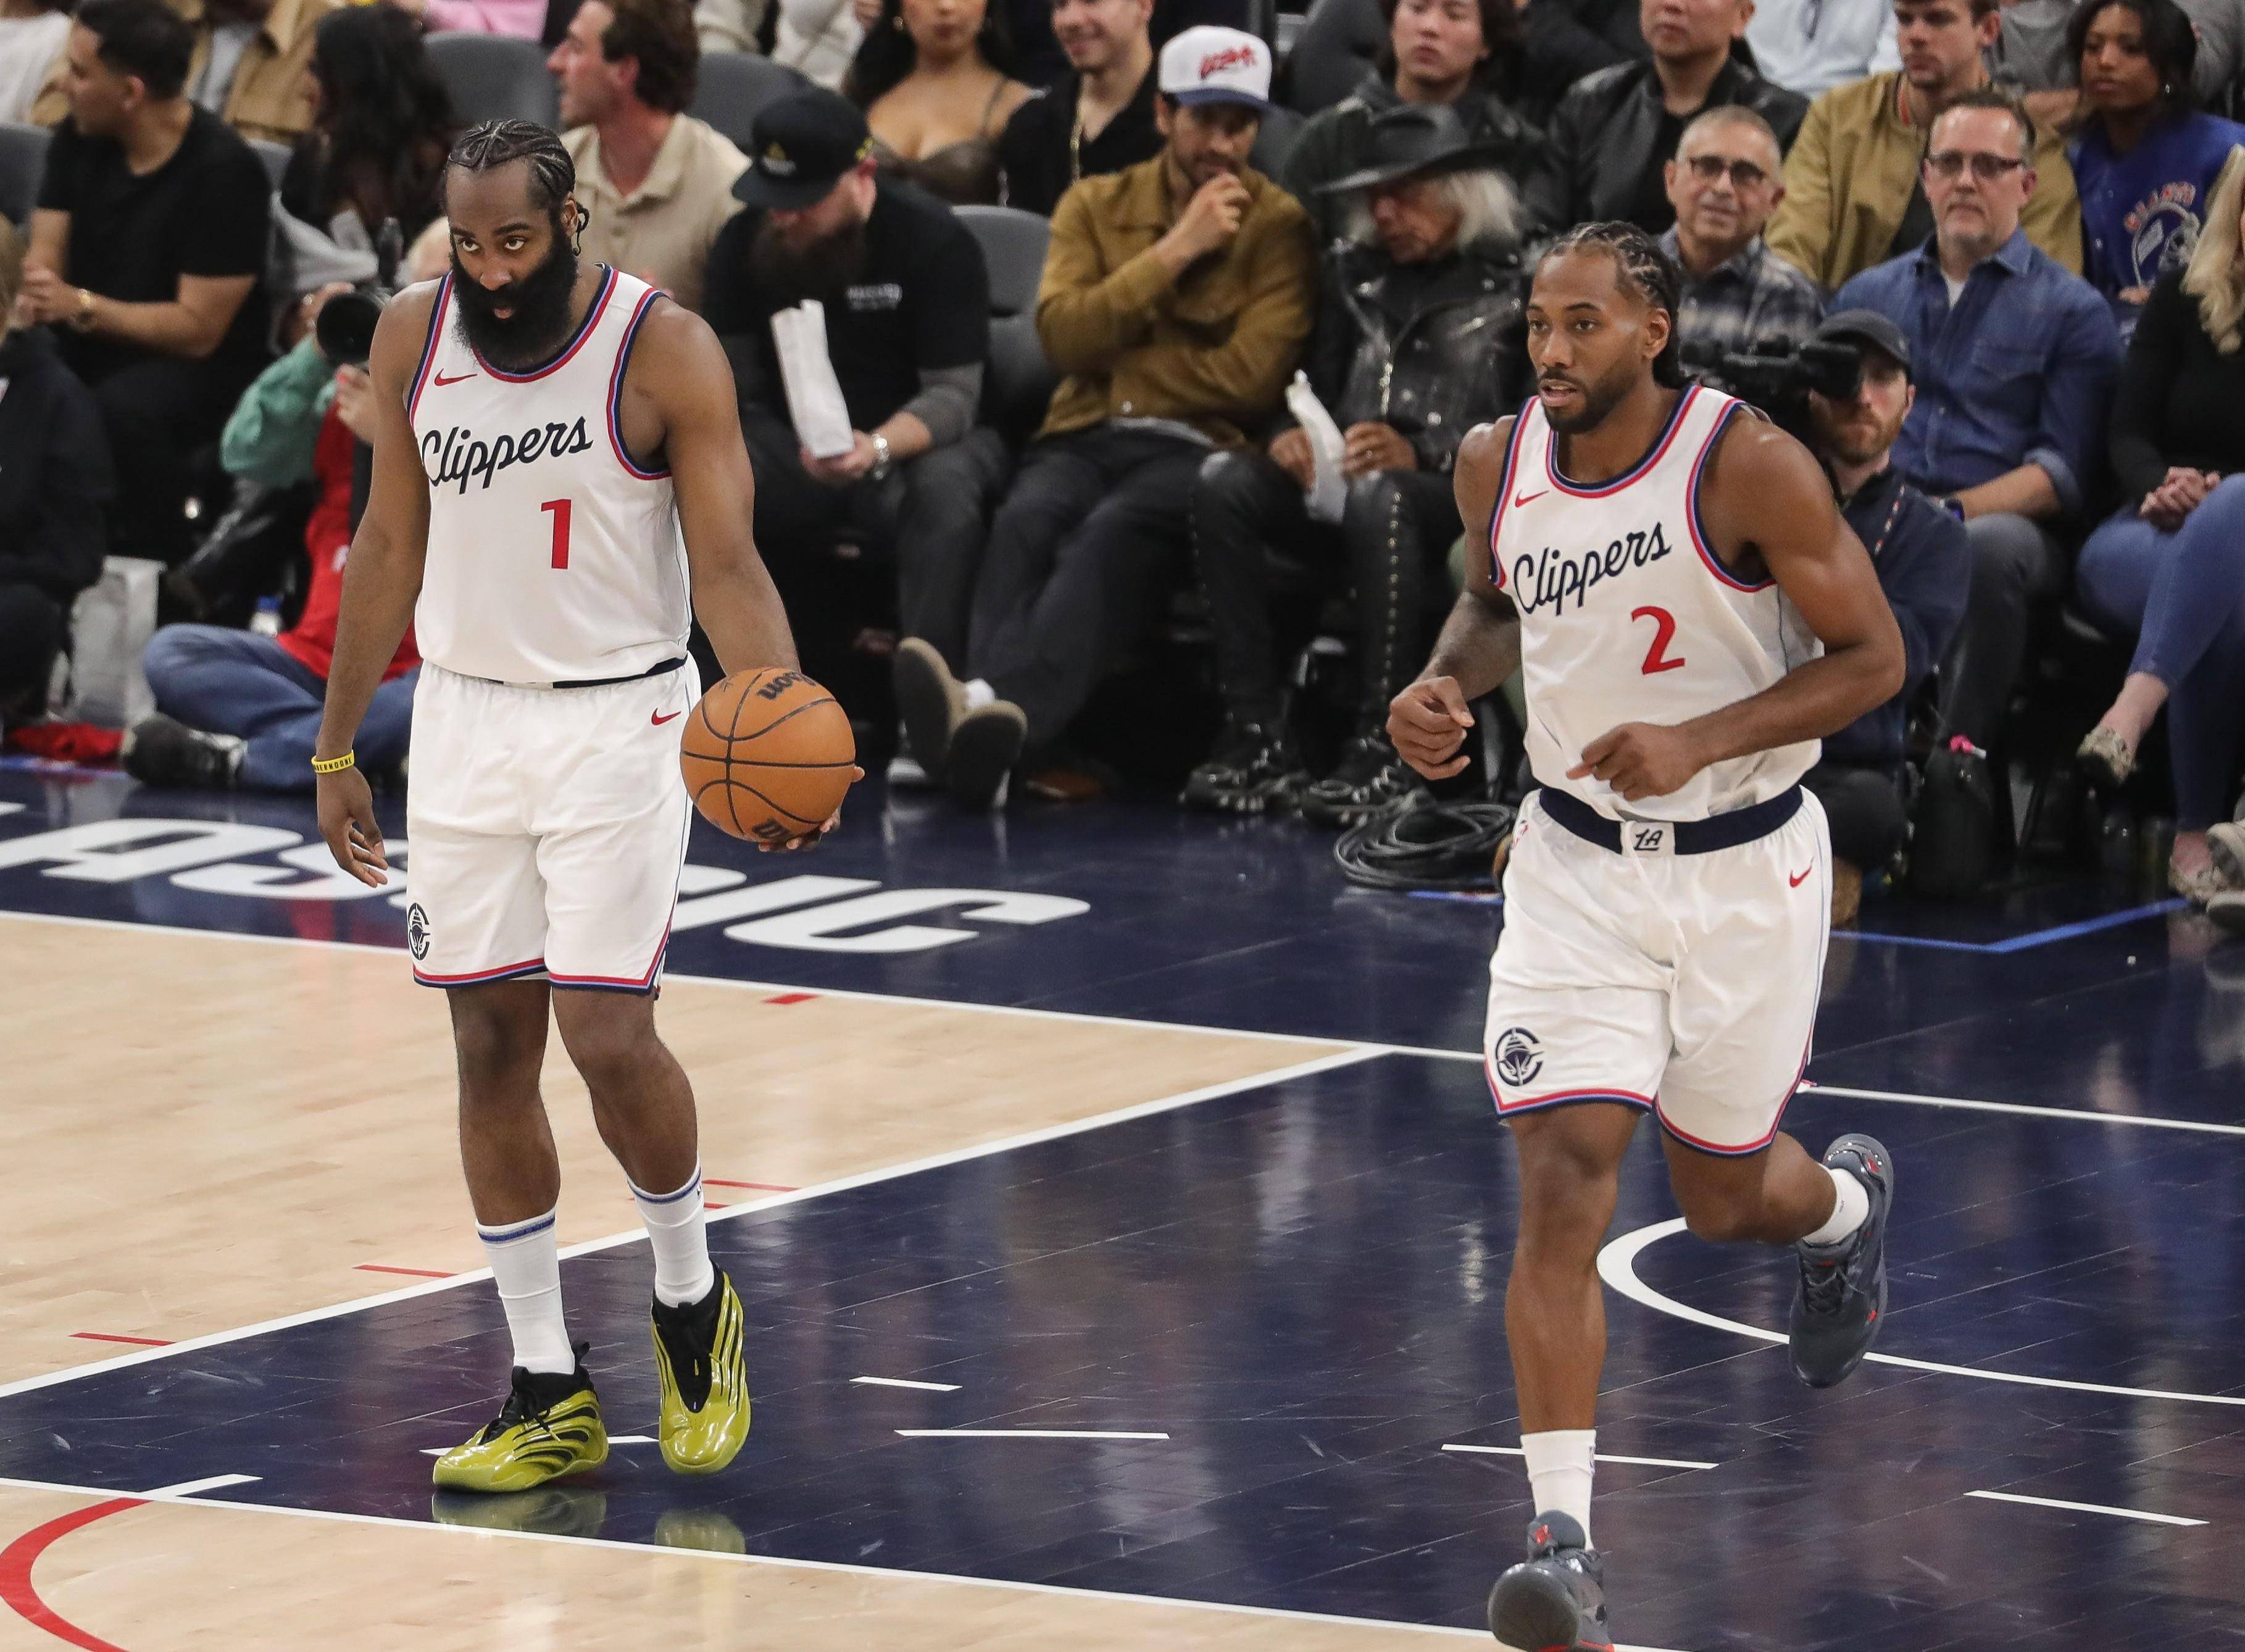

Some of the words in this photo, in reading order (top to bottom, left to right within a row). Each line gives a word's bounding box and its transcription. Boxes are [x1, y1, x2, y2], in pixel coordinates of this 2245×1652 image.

[422, 415, 594, 495] Clippers
[540, 498, 572, 570] 1
[1514, 522, 1673, 617] Clippers
[1631, 605, 1686, 675] 2
[1634, 828, 1663, 851] LA
